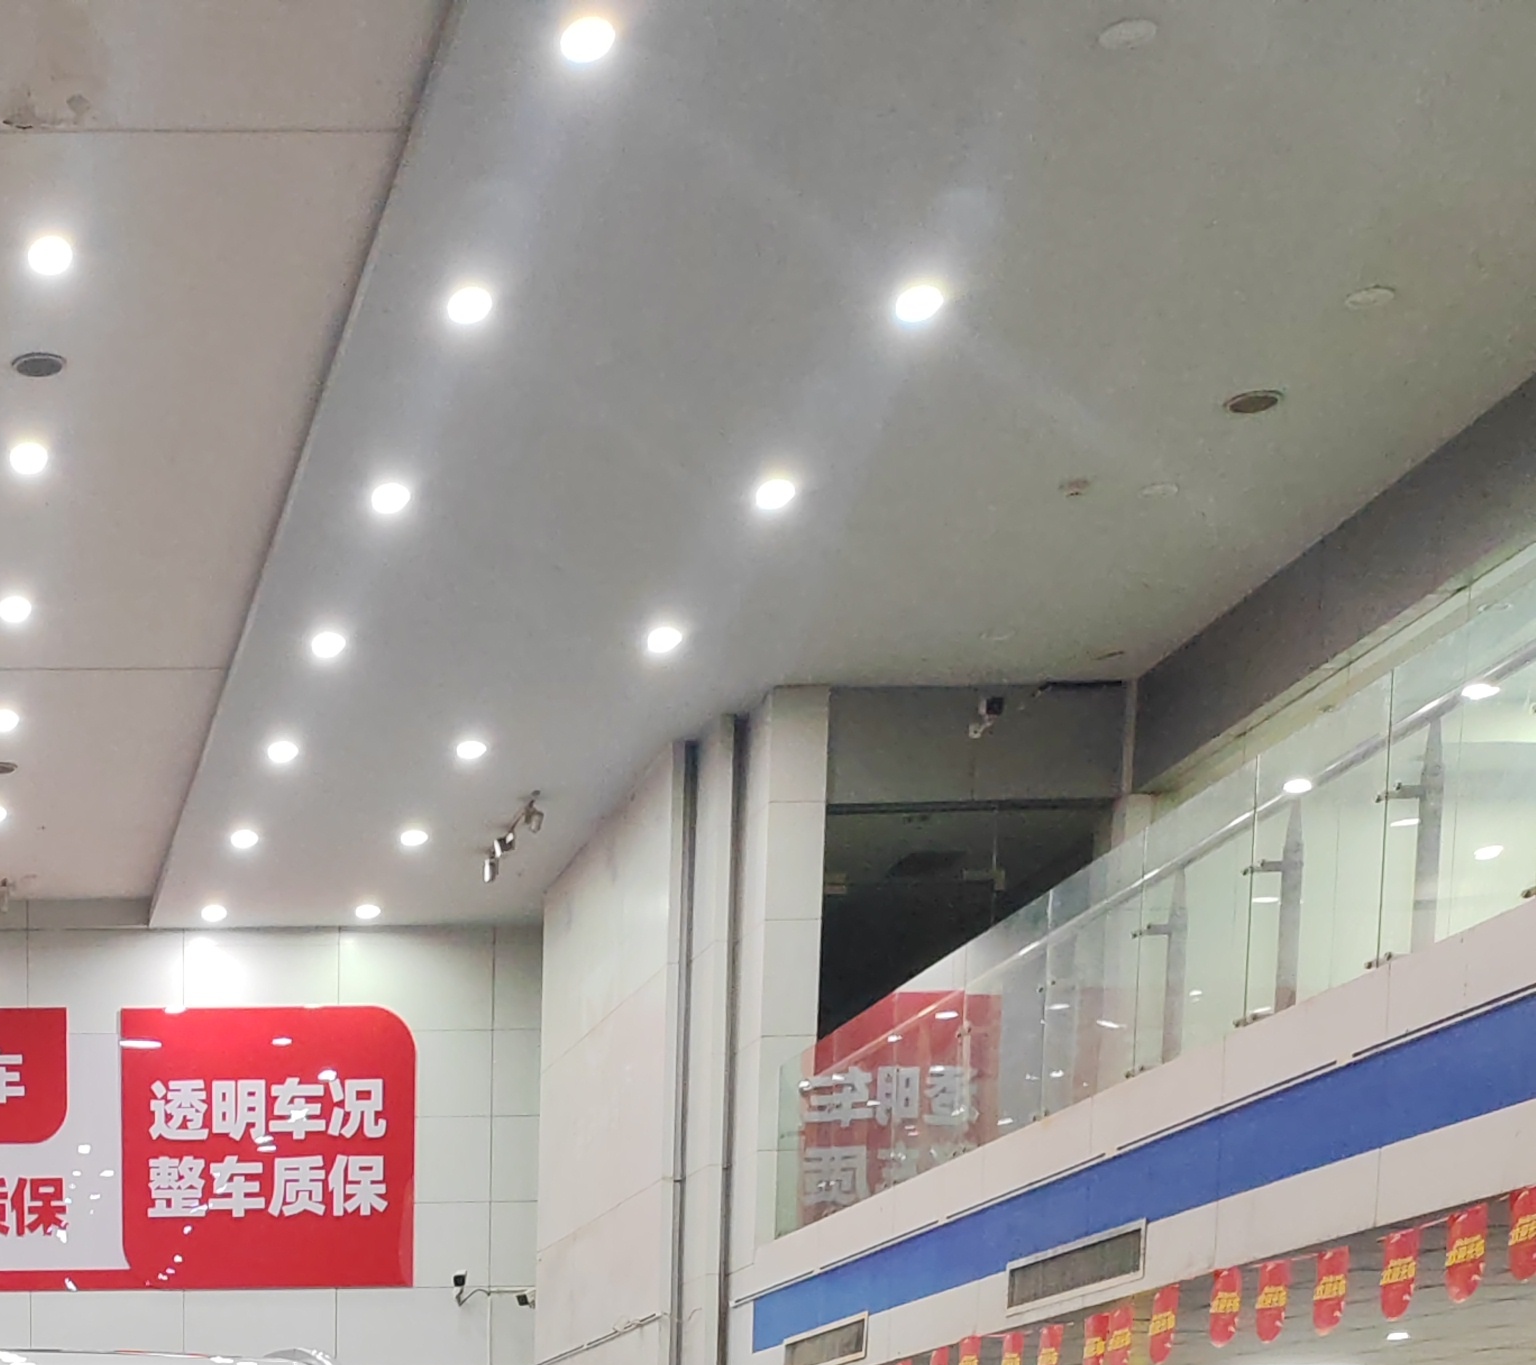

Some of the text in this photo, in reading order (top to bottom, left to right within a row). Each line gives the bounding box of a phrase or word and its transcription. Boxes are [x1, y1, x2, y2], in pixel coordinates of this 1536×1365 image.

[148, 1077, 389, 1141] 透明车况
[147, 1154, 390, 1219] 整车质保
